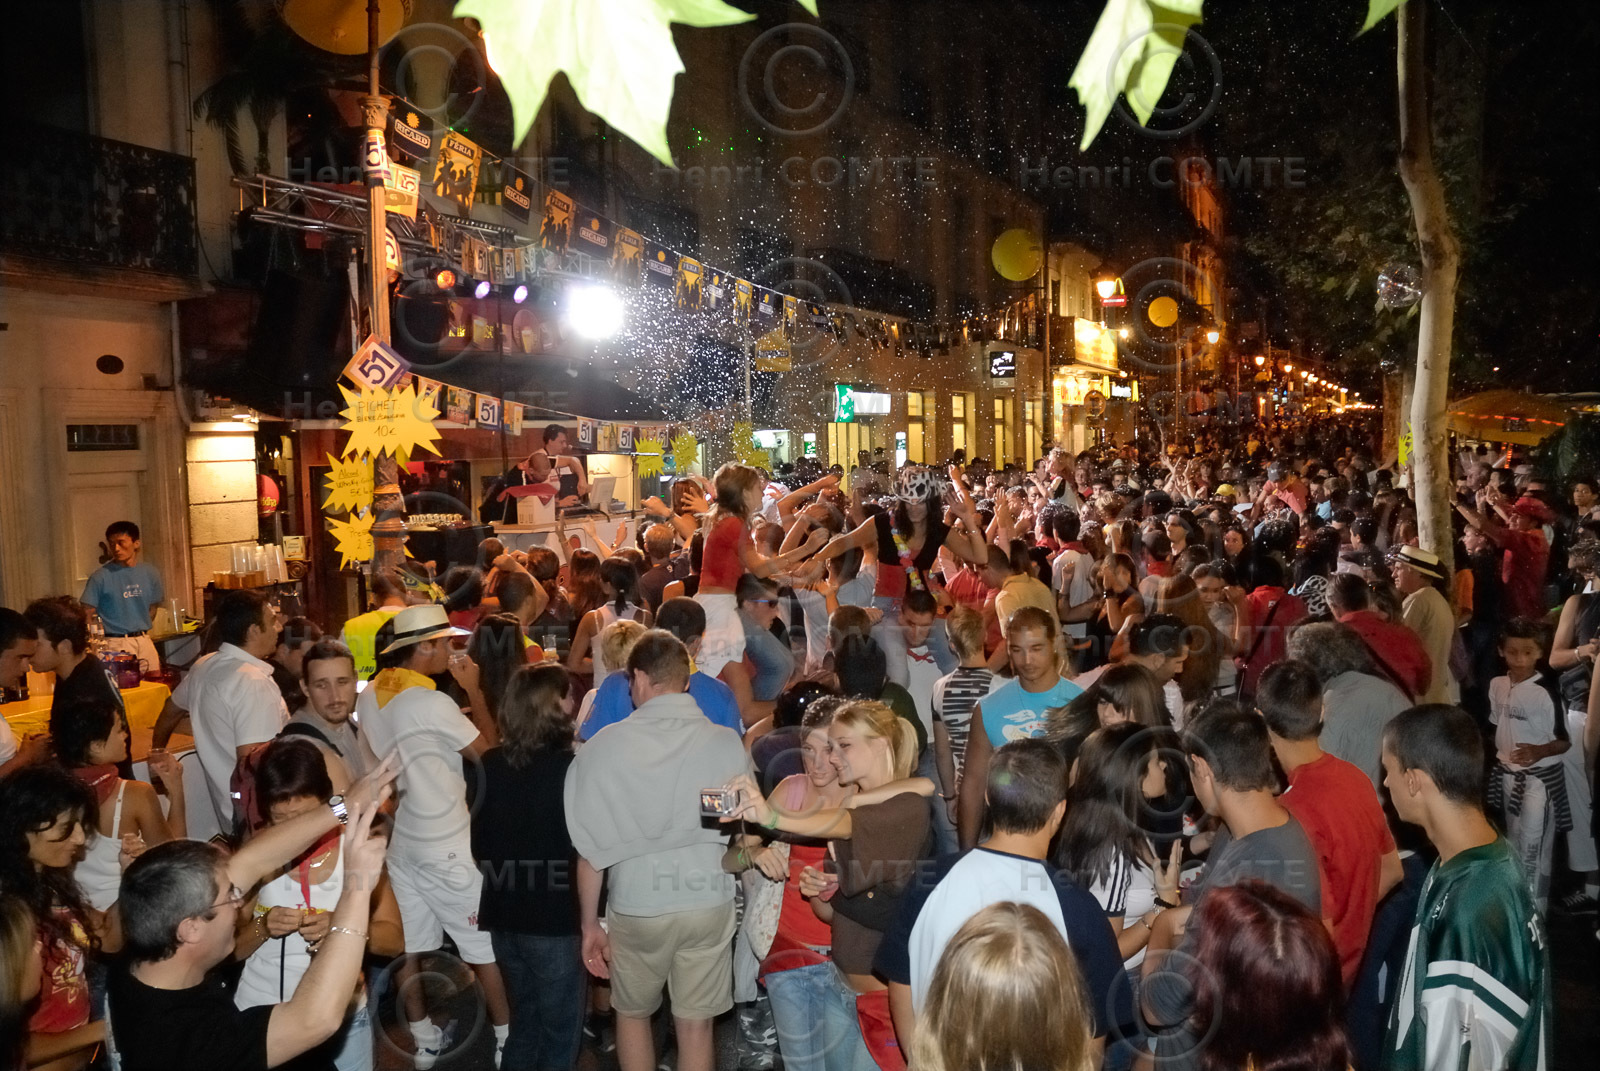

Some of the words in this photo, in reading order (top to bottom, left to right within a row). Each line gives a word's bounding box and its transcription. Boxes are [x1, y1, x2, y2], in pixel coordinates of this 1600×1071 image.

[397, 122, 428, 146] RICARD
[401, 173, 417, 191] 51
[506, 189, 528, 207] RICARD
[582, 230, 605, 245] RICARD
[358, 350, 395, 385] 51
[481, 403, 495, 423] 51
[580, 423, 591, 442] 51
[620, 430, 631, 447] 51
